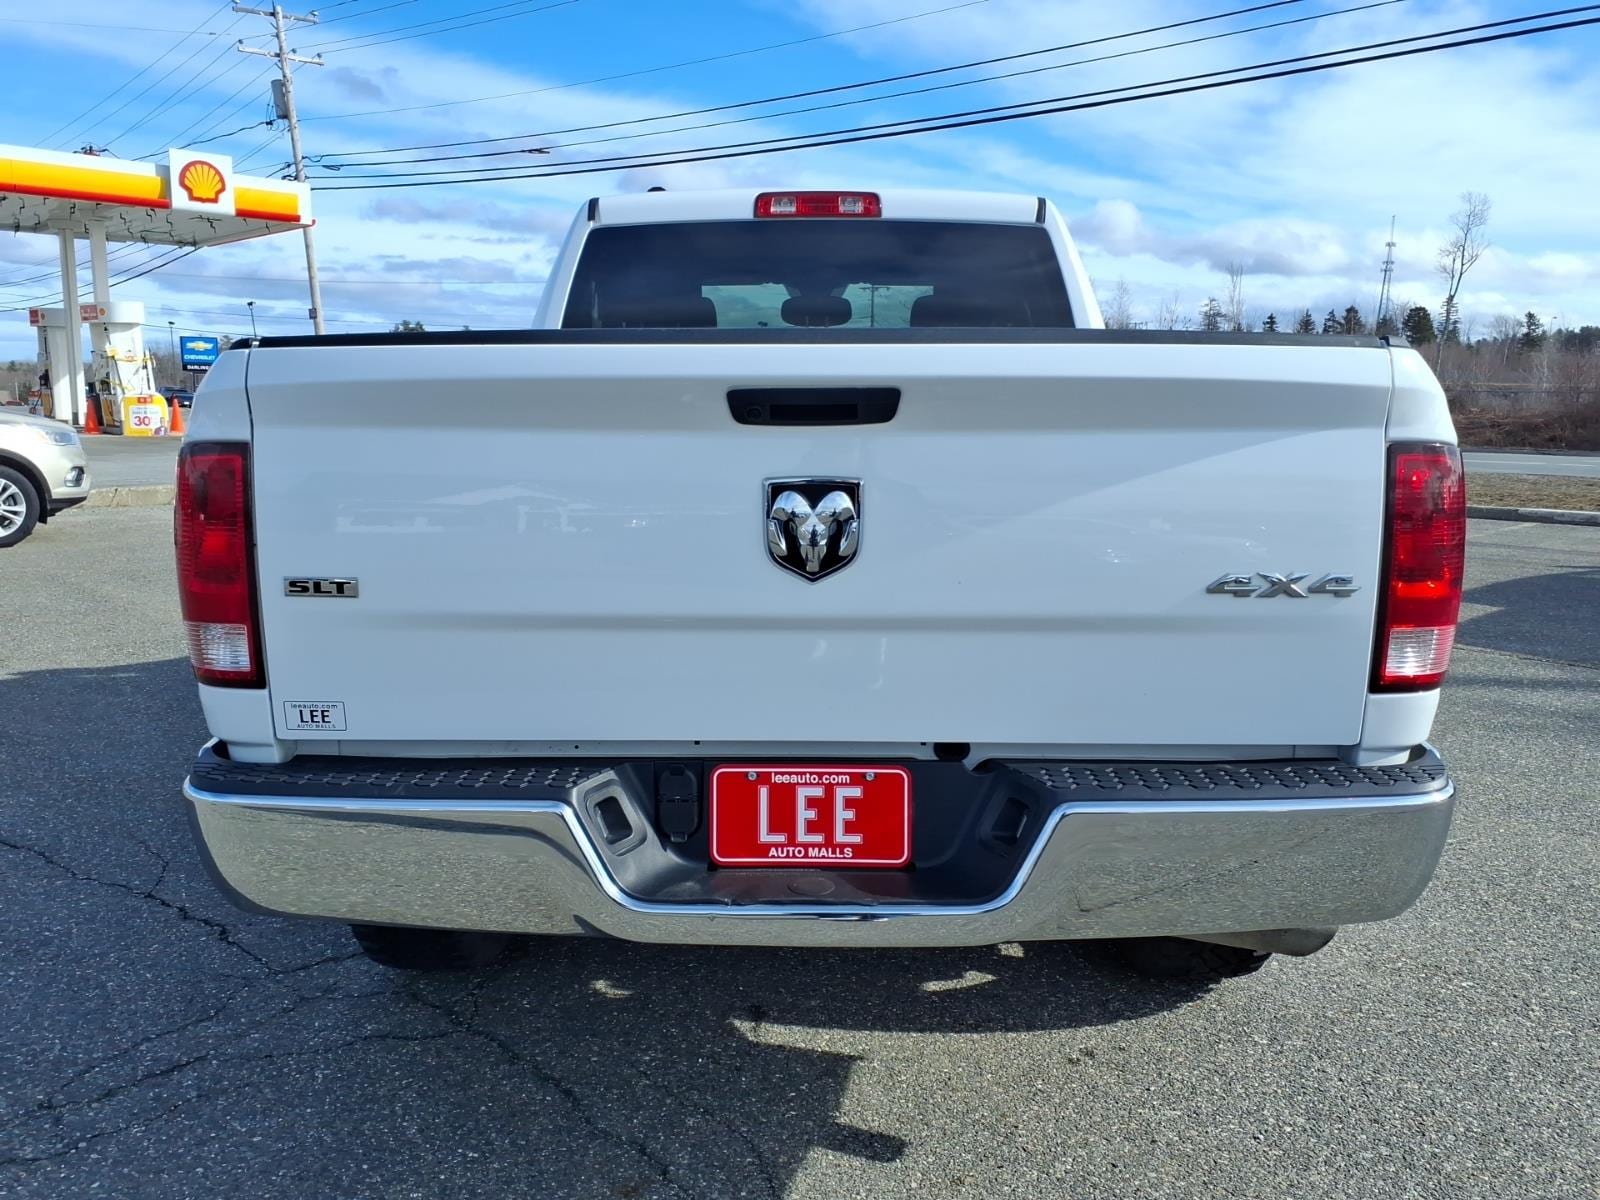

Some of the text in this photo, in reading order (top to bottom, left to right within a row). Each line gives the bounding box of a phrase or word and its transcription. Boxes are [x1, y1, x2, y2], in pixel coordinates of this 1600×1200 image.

[288, 580, 352, 595] SLT
[290, 702, 338, 710] leeauto.com
[299, 709, 332, 724] LEE
[771, 772, 850, 784] leeauto.com
[757, 785, 864, 844] LEE
[768, 847, 853, 858] AUTO MALLS
